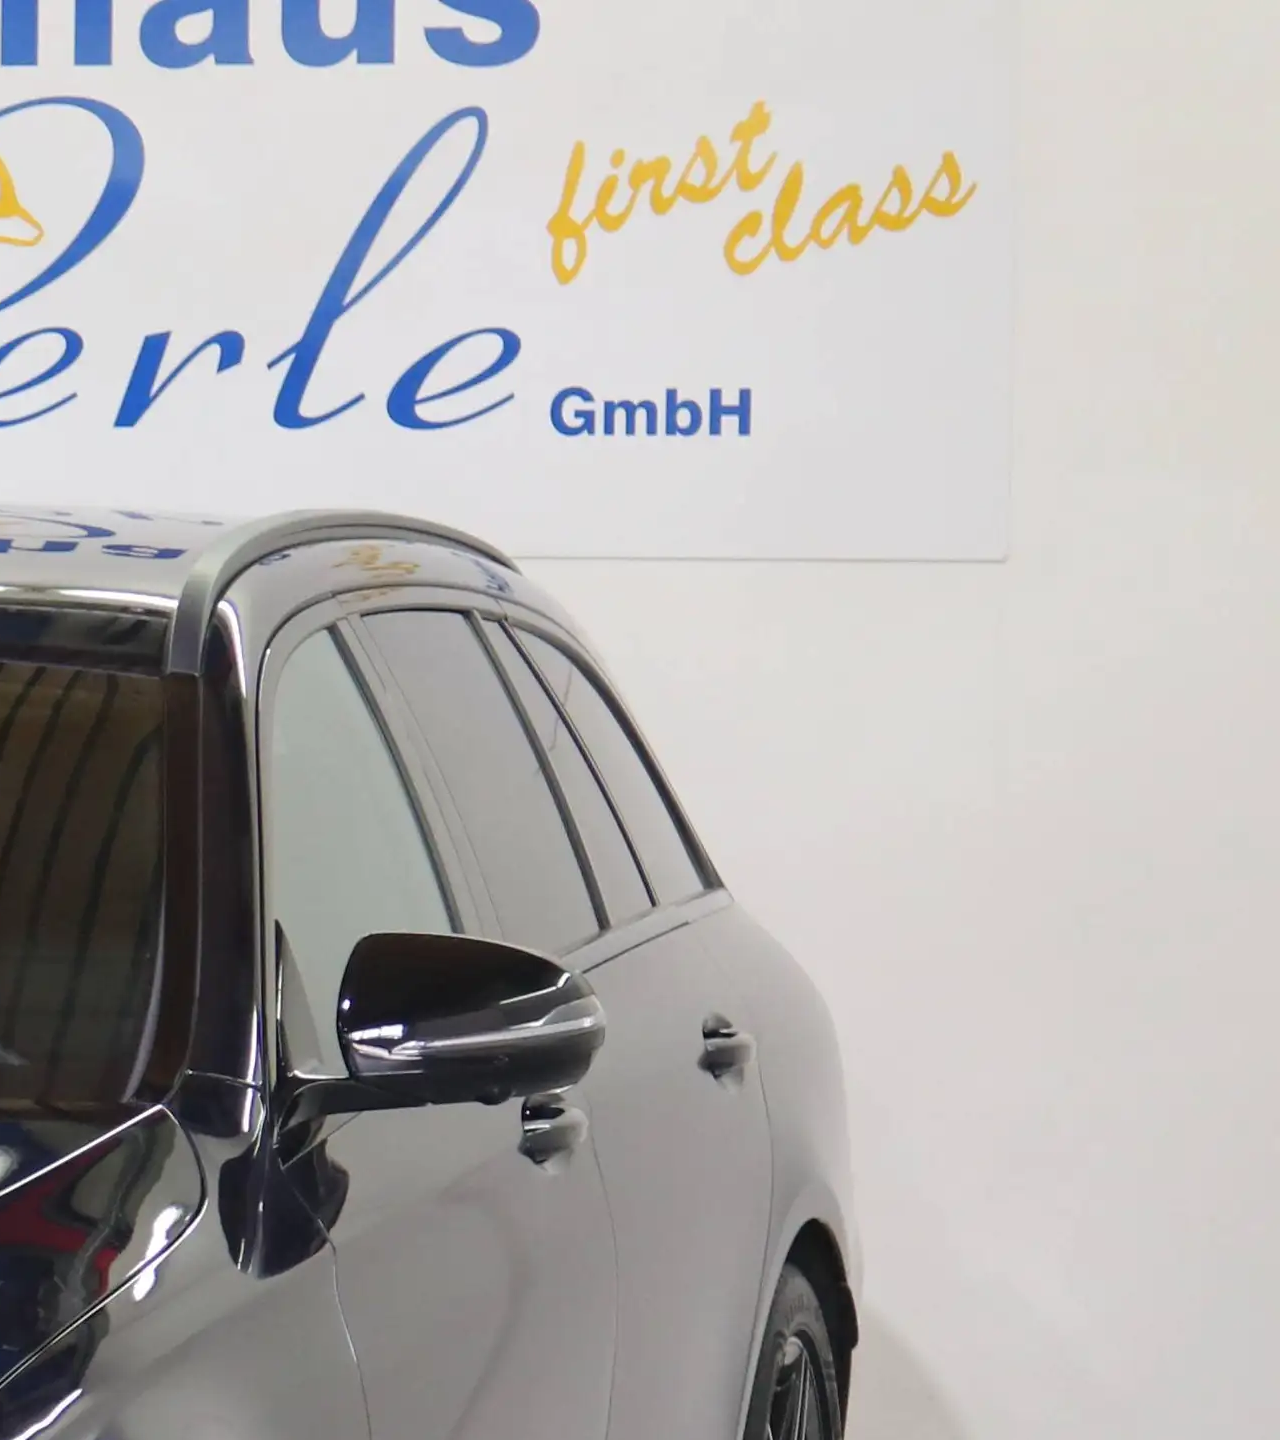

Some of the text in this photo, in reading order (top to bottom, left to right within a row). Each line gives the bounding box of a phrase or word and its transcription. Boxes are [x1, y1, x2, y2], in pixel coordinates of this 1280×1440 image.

[546, 100, 977, 285] first class
[549, 387, 752, 438] GmbH
